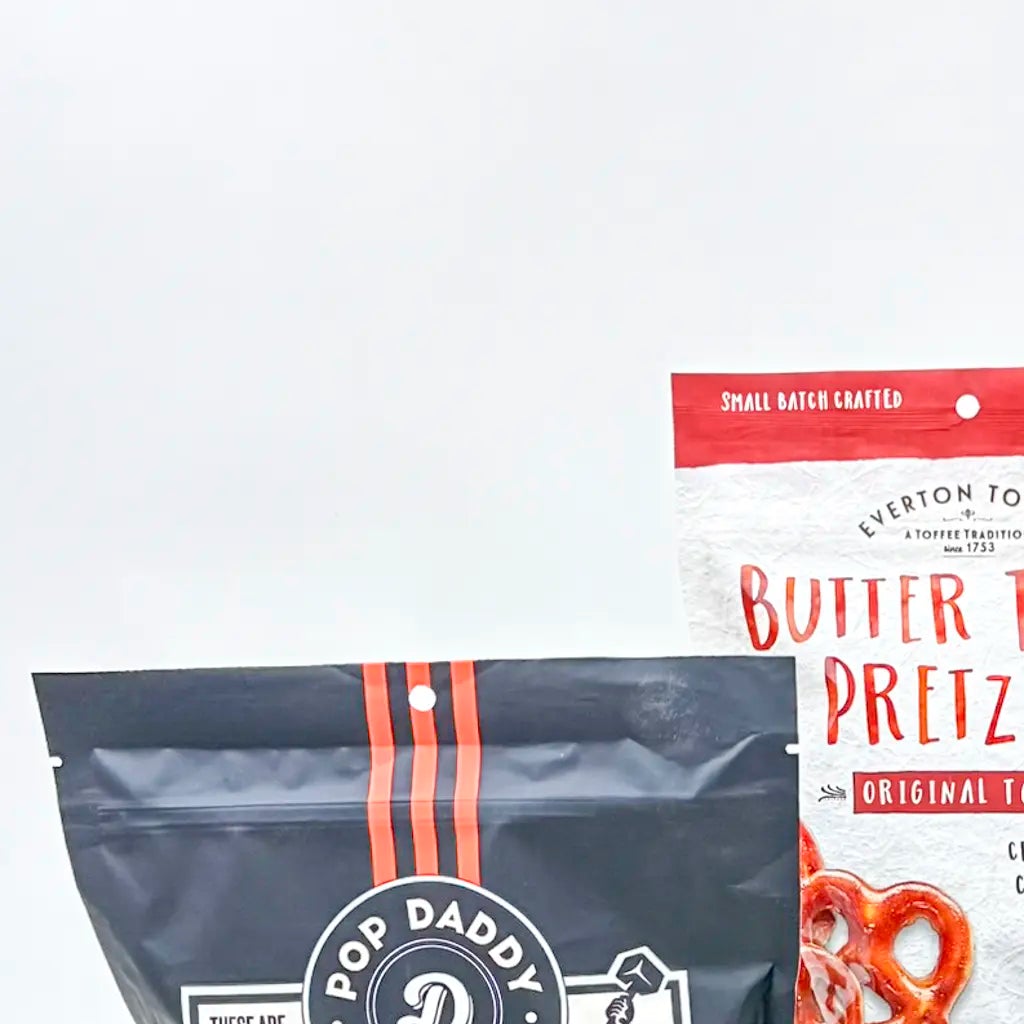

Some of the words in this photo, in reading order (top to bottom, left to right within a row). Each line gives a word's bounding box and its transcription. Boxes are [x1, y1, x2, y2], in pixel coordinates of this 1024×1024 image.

[721, 390, 772, 411] SMALL
[777, 389, 829, 411] BATCH
[834, 388, 902, 410] CRAFTED
[858, 483, 973, 539] EVERTON
[905, 530, 912, 539] A
[915, 529, 960, 540] TOFFEE
[944, 543, 963, 553] since
[966, 542, 995, 553] 1753
[740, 563, 971, 652] BUTTER
[862, 777, 989, 806] ORIGINAL
[325, 915, 388, 1001] POP
[406, 897, 543, 995] DADDY
